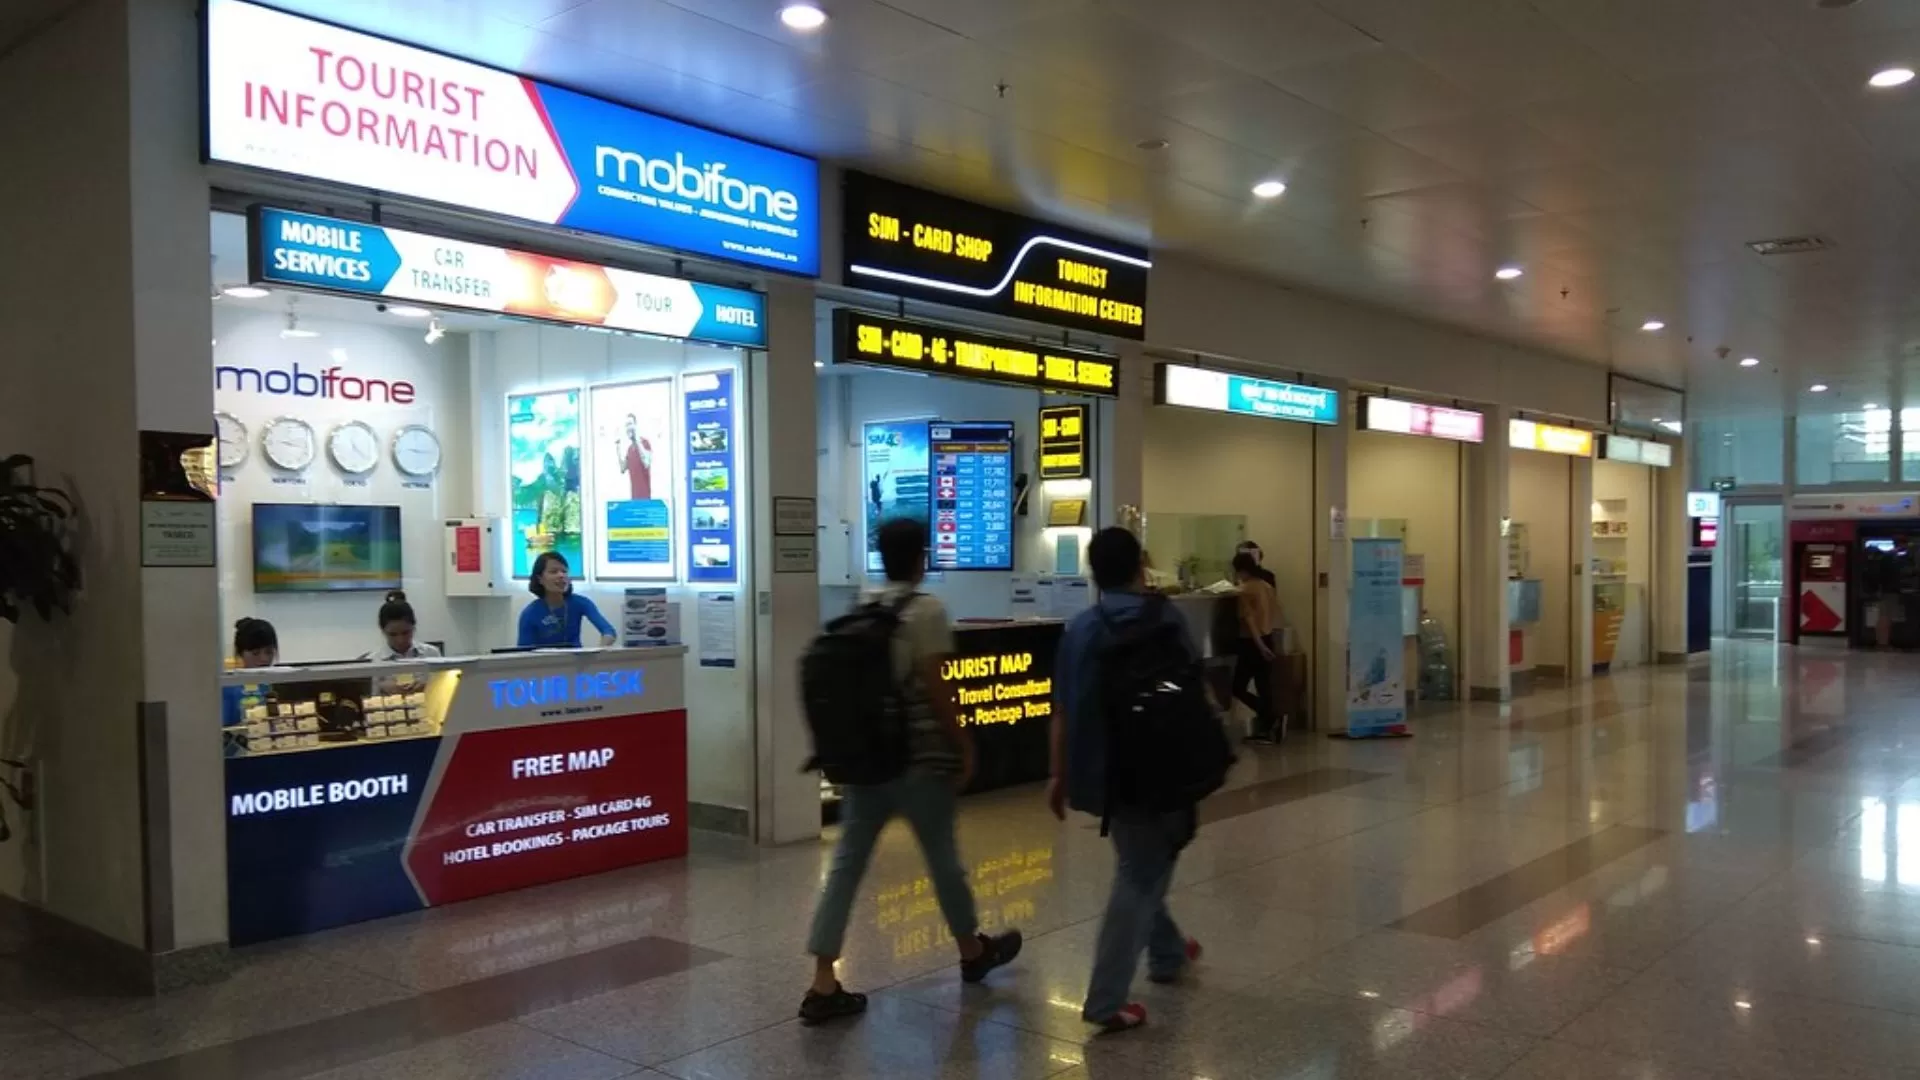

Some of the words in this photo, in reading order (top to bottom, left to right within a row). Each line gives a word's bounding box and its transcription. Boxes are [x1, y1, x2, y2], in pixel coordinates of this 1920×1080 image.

[308, 47, 486, 122] TOURIST
[243, 81, 538, 180] INFORMATION
[595, 144, 799, 222] mobifone
[281, 219, 362, 253] MOBILE
[868, 212, 900, 242] SIM
[913, 223, 953, 254] CARD
[956, 232, 993, 262] SHOP
[273, 248, 371, 282] SERVICES
[434, 247, 465, 269] CAR
[1058, 258, 1108, 289] TOURIST
[411, 268, 492, 298] TRANSFER
[635, 291, 673, 313] TOUR
[715, 303, 758, 328] HOTEL
[1013, 280, 1098, 317] INFORMATION
[1099, 297, 1143, 327] CENTER
[216, 362, 416, 405] mobifone
[940, 656, 996, 681] OURIST
[1000, 653, 1032, 675] MAP
[488, 674, 569, 709] TOUR
[575, 669, 645, 703] DESK
[958, 685, 993, 706] Travel
[995, 677, 1052, 701] Consultant
[975, 704, 1023, 726] Package
[1023, 701, 1052, 718] Tours
[511, 753, 563, 780] FREE
[568, 747, 615, 772] MAP
[231, 784, 324, 816] MOBILE
[328, 774, 408, 802] BOOTH
[465, 820, 495, 838] CAR
[496, 809, 565, 832] TRANSFER
[574, 803, 599, 820] SIM
[600, 798, 635, 817] CARD
[635, 795, 652, 810] 4G
[443, 844, 491, 866] HOTEL
[492, 830, 563, 858] BOOKINGS
[572, 820, 630, 843] PACKAGE
[631, 812, 670, 832] TOURS
